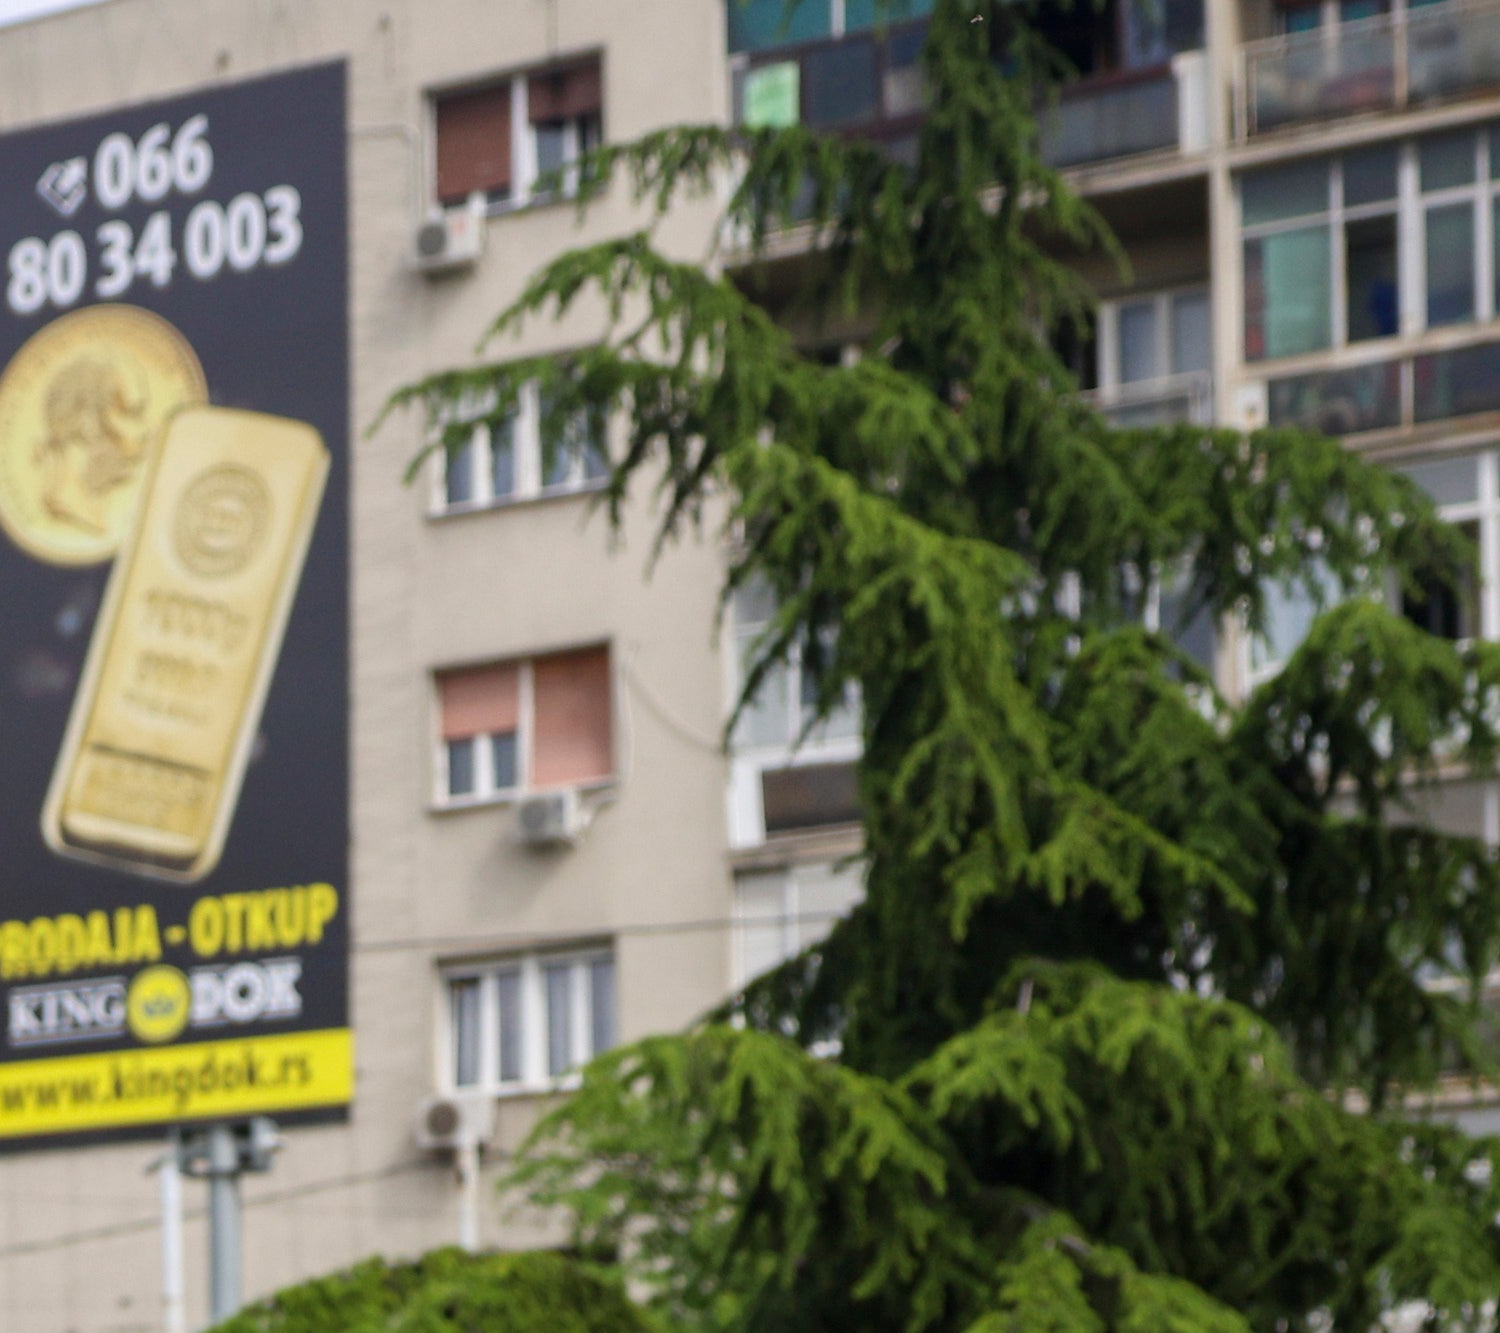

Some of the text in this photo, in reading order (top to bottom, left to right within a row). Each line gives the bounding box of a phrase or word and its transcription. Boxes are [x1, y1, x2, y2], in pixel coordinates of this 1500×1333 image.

[94, 114, 213, 208] 066
[7, 184, 303, 313] 80 34 003
[188, 882, 339, 957] OTKUP
[9, 957, 303, 1047] KING DOK
[0, 1050, 314, 1113] www.kingdok.rs
